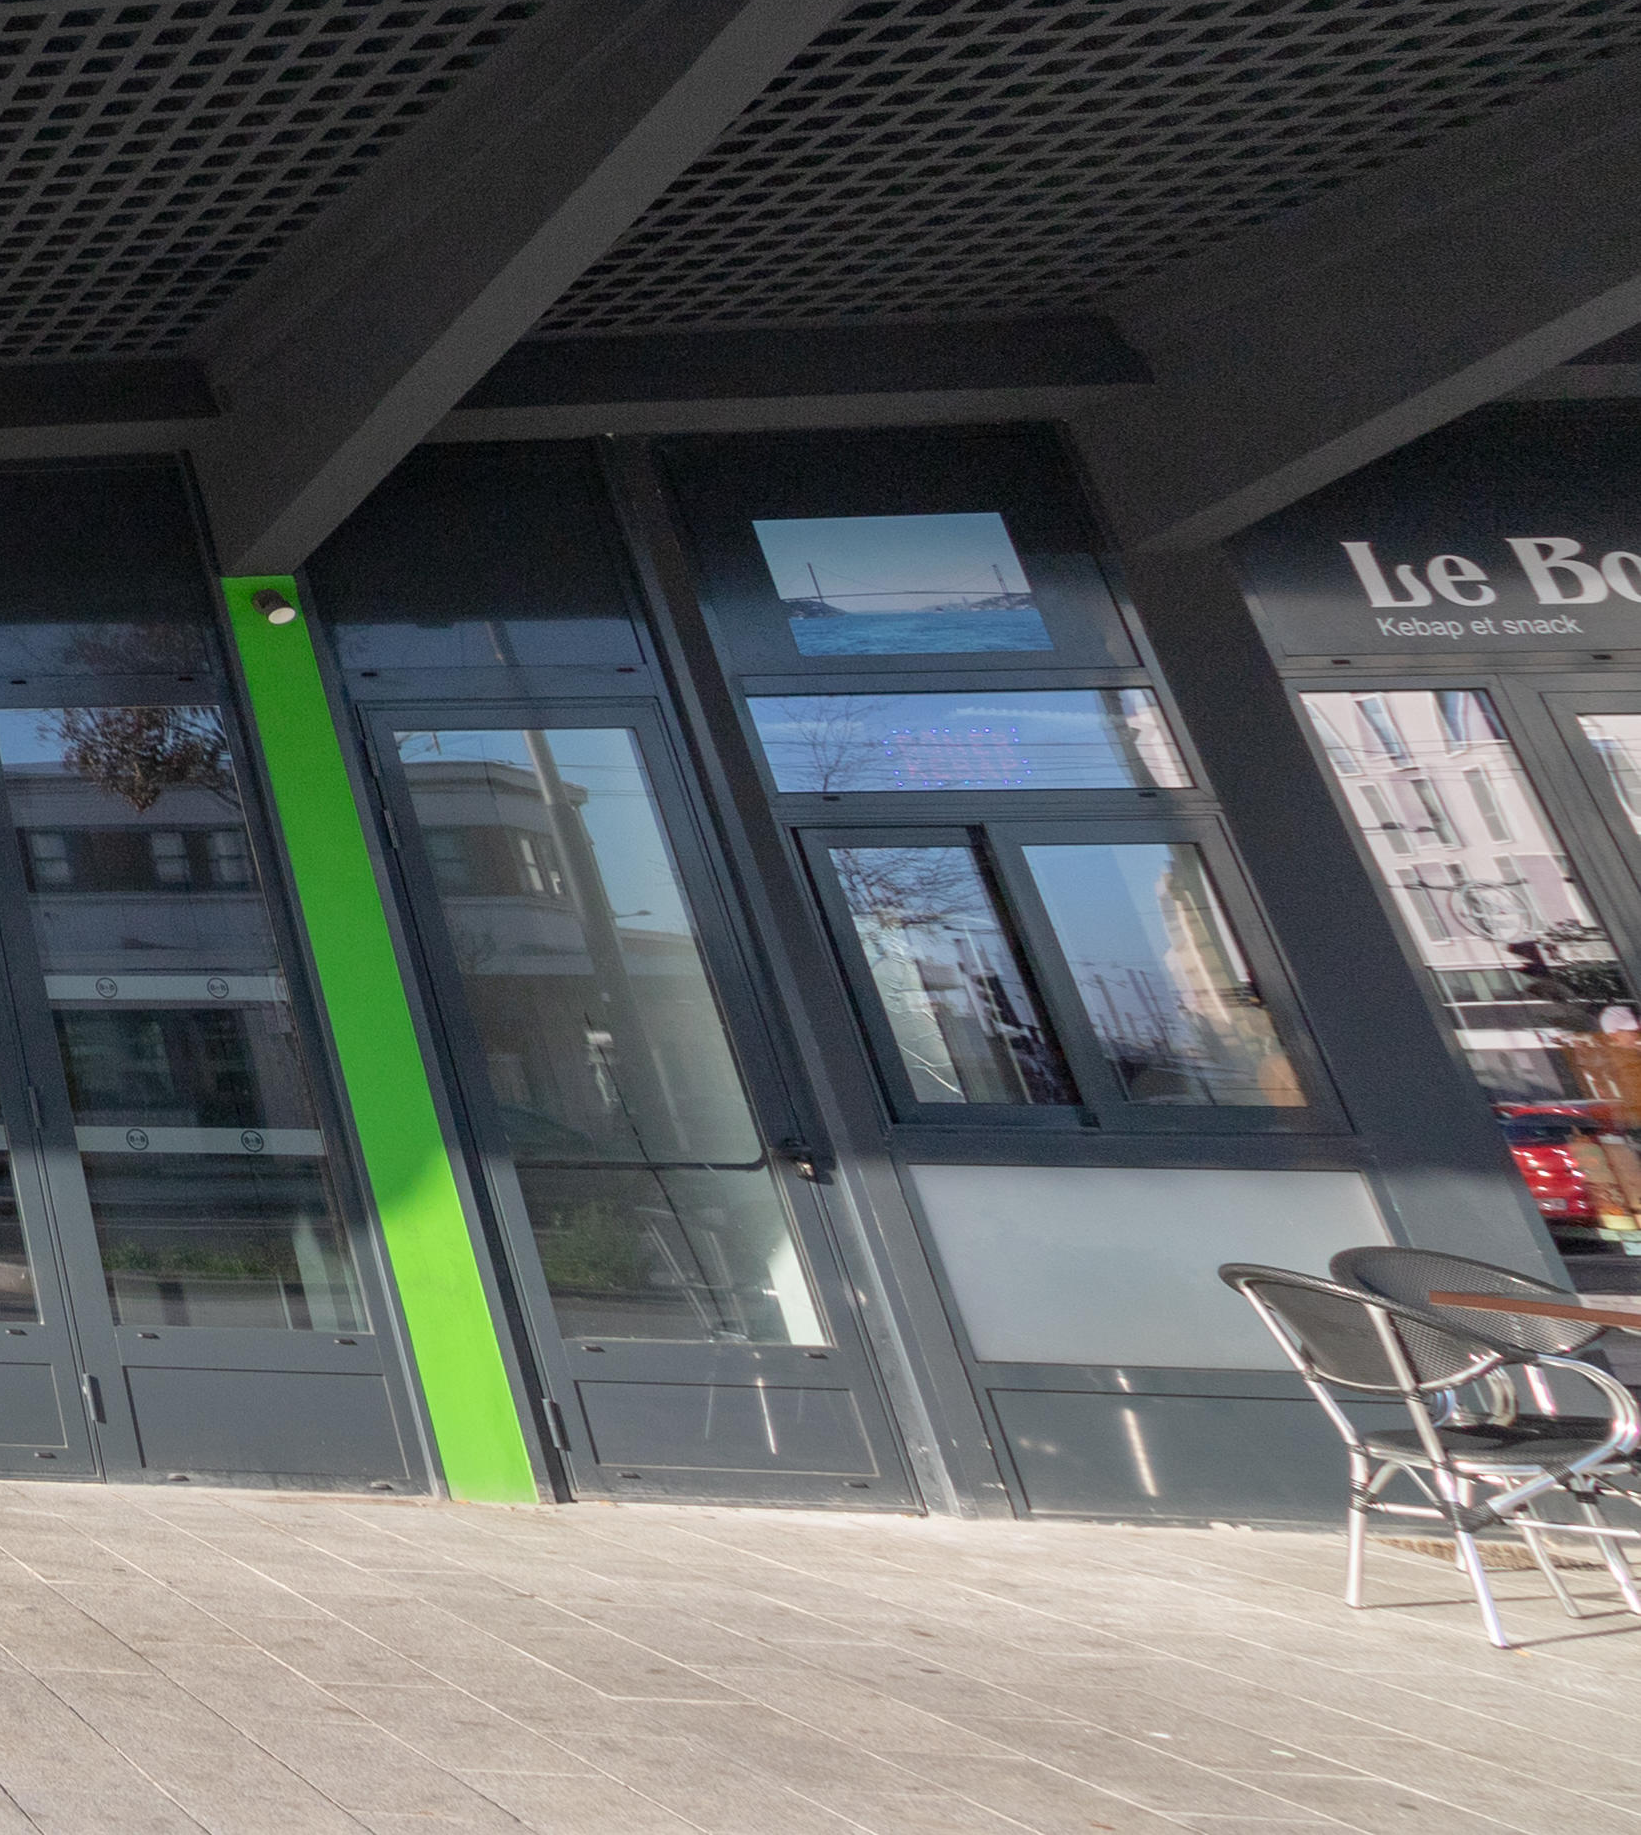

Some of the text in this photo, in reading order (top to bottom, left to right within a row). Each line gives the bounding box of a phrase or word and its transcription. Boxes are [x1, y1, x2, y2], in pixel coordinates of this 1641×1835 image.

[1339, 540, 1496, 608] Le
[1376, 615, 1584, 639] Kebap et snack
